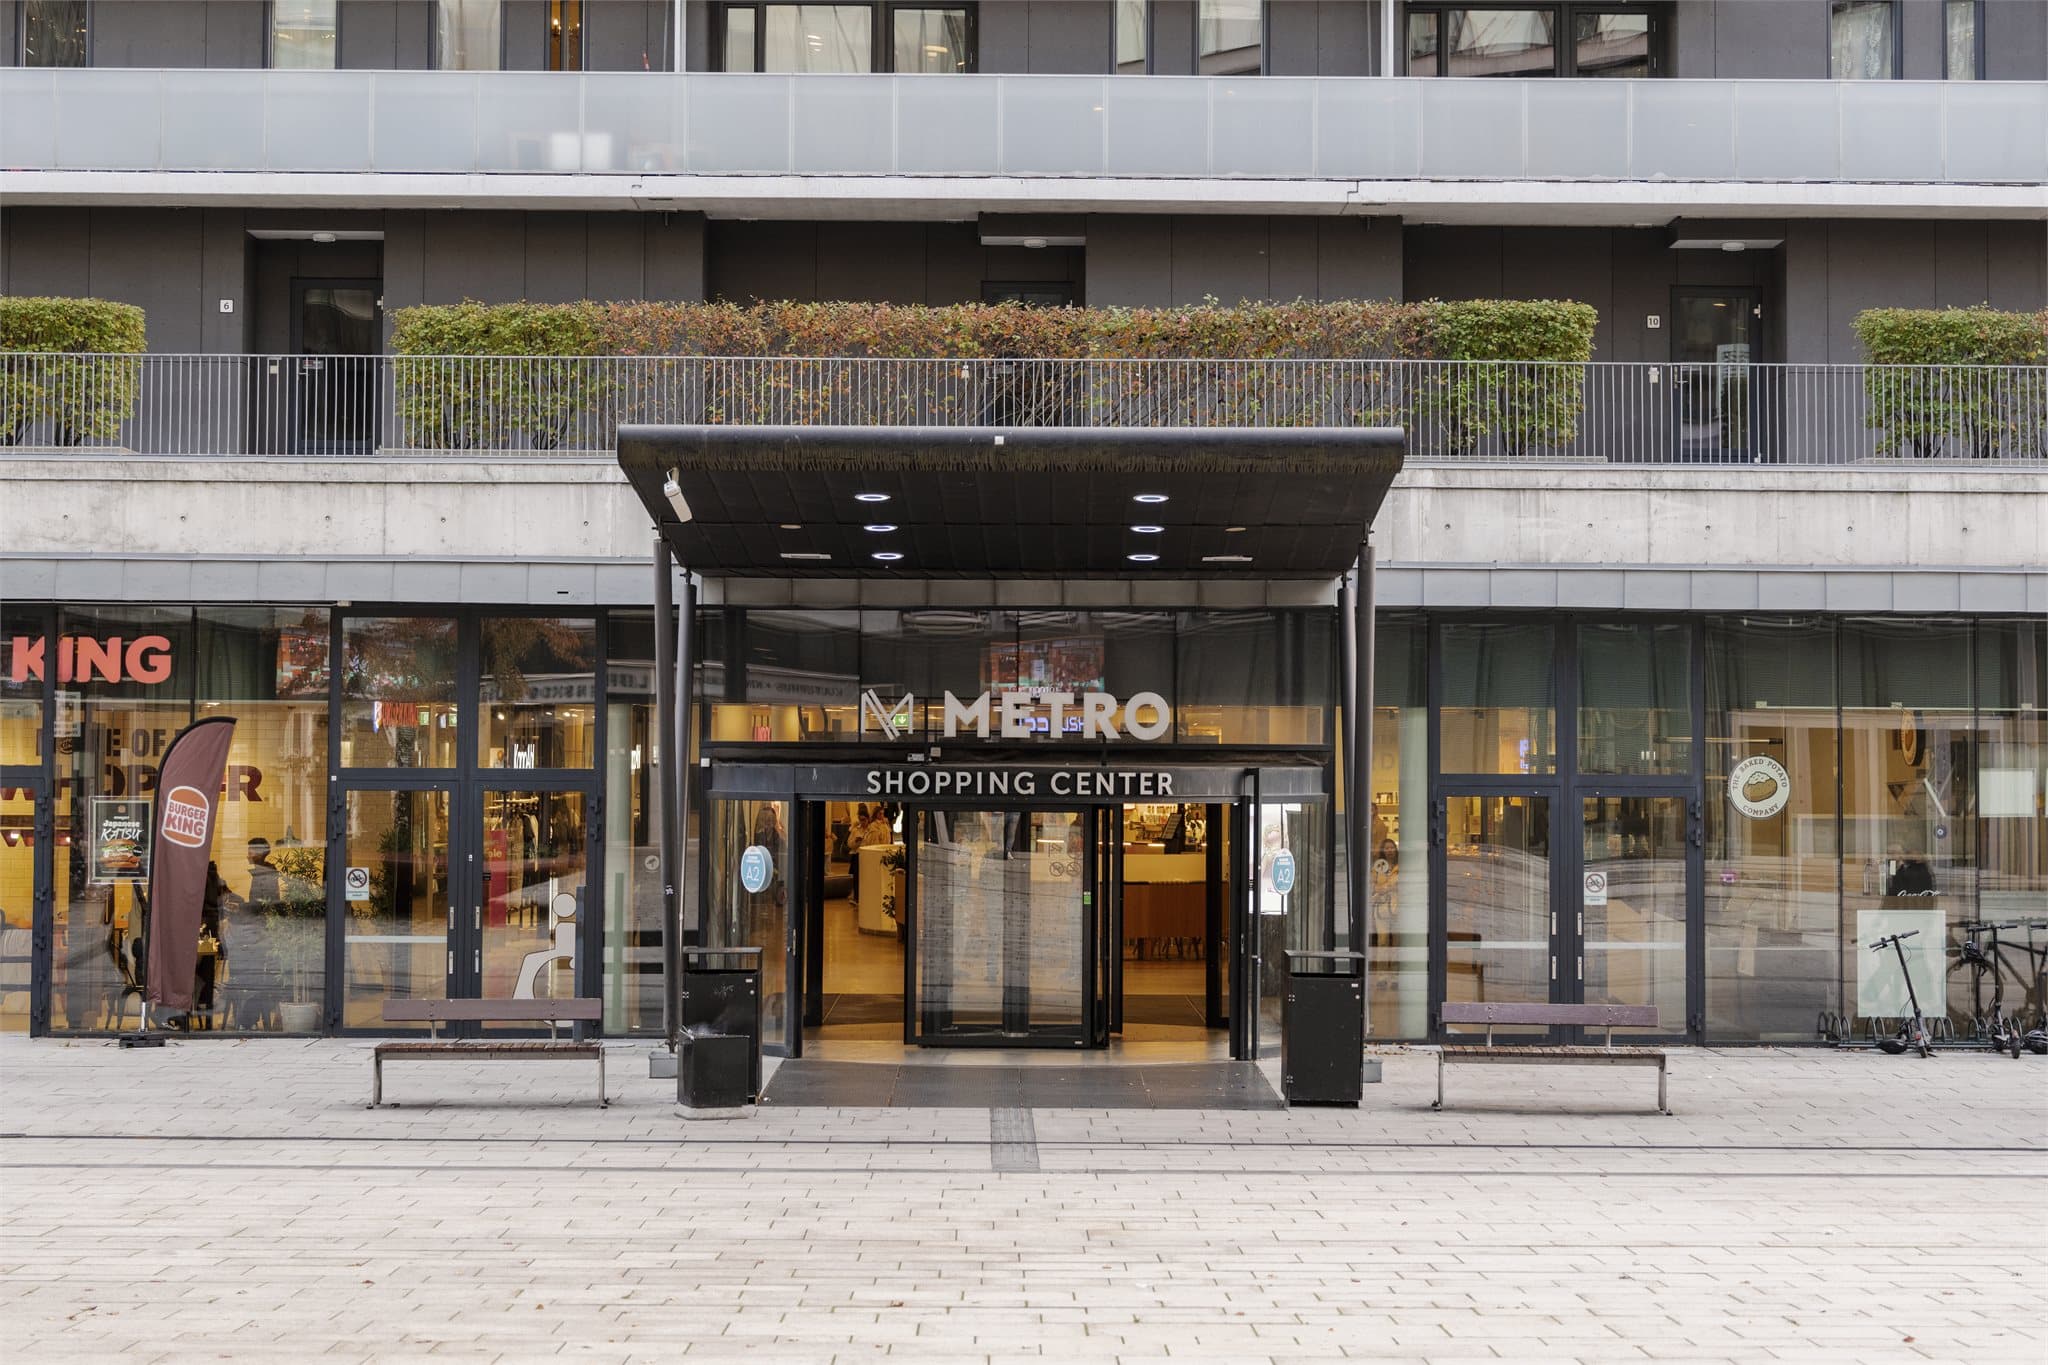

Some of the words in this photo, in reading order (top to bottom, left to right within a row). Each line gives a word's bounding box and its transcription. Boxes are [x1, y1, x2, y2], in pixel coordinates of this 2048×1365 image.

[223, 300, 231, 310] 6
[1648, 317, 1659, 326] 10
[11, 635, 172, 684] KING
[943, 690, 1171, 741] METRO
[1739, 759, 1764, 773] BAKED
[1767, 760, 1788, 788] POTATO
[866, 770, 1036, 796] SHOPPING
[1050, 771, 1174, 796] CENTER
[168, 802, 206, 821] BURGER
[1742, 803, 1779, 816] COMPANY
[165, 814, 205, 837] KING
[101, 828, 143, 841] KATSU
[746, 866, 760, 881] A2
[1277, 868, 1290, 883] A2
